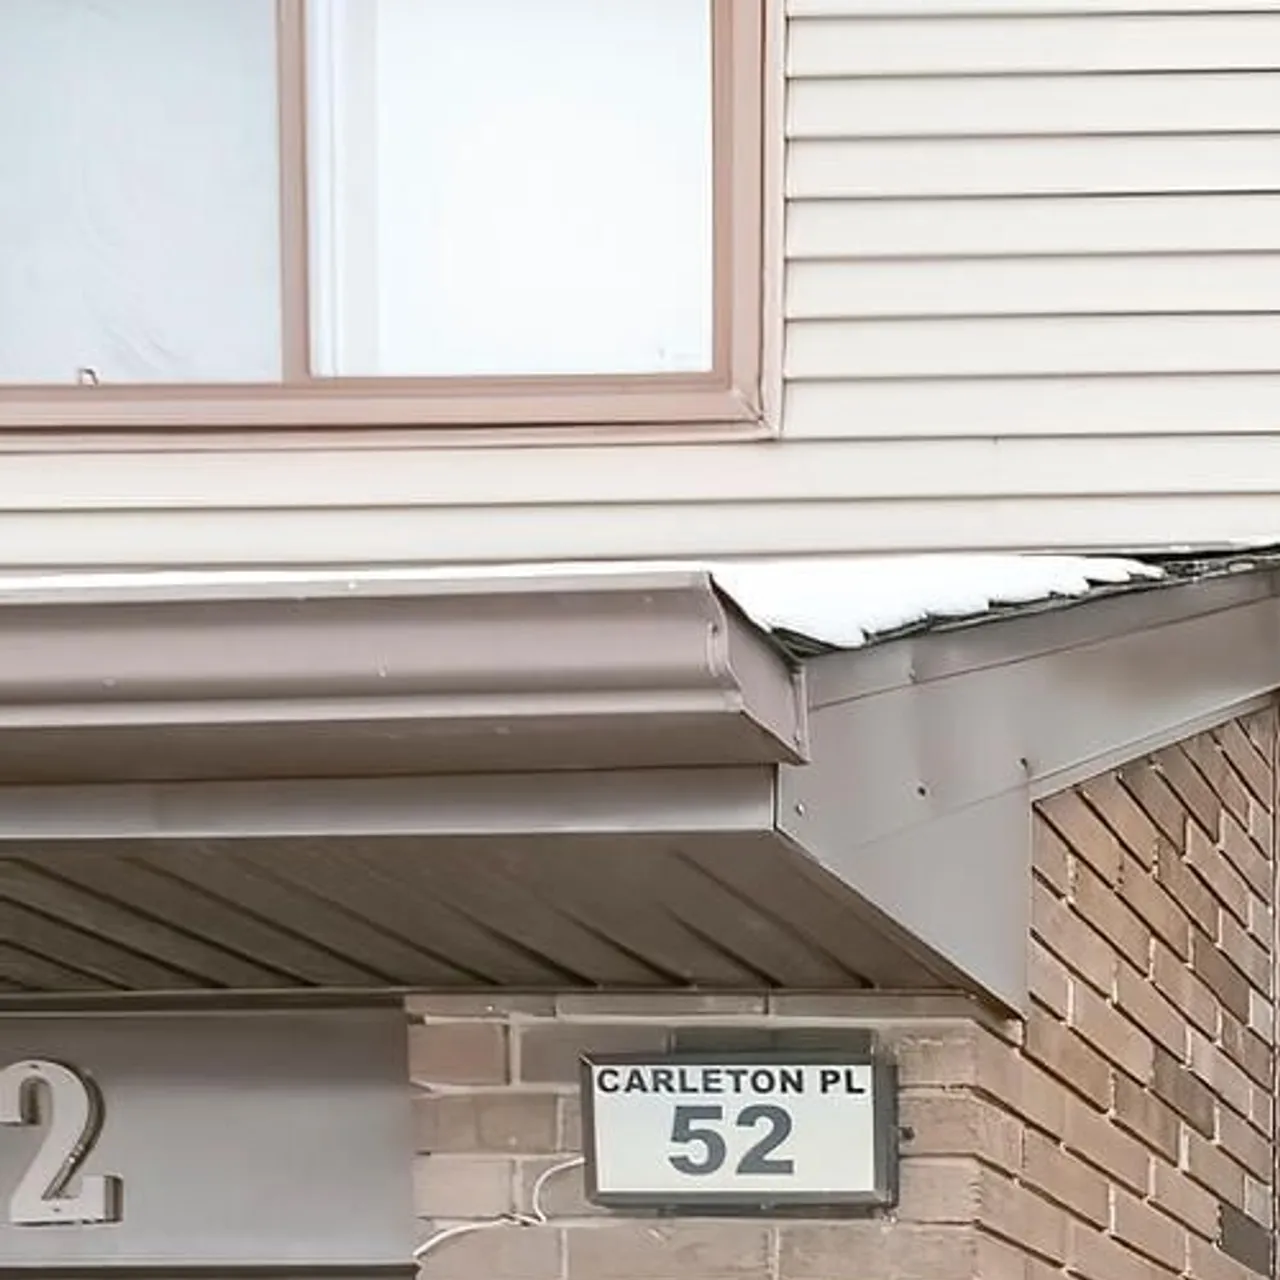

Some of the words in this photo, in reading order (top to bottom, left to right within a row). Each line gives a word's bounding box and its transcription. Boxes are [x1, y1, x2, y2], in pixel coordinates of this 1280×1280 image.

[596, 1068, 804, 1094] CARLETON
[819, 1069, 866, 1094] PL
[668, 1103, 794, 1176] 52
